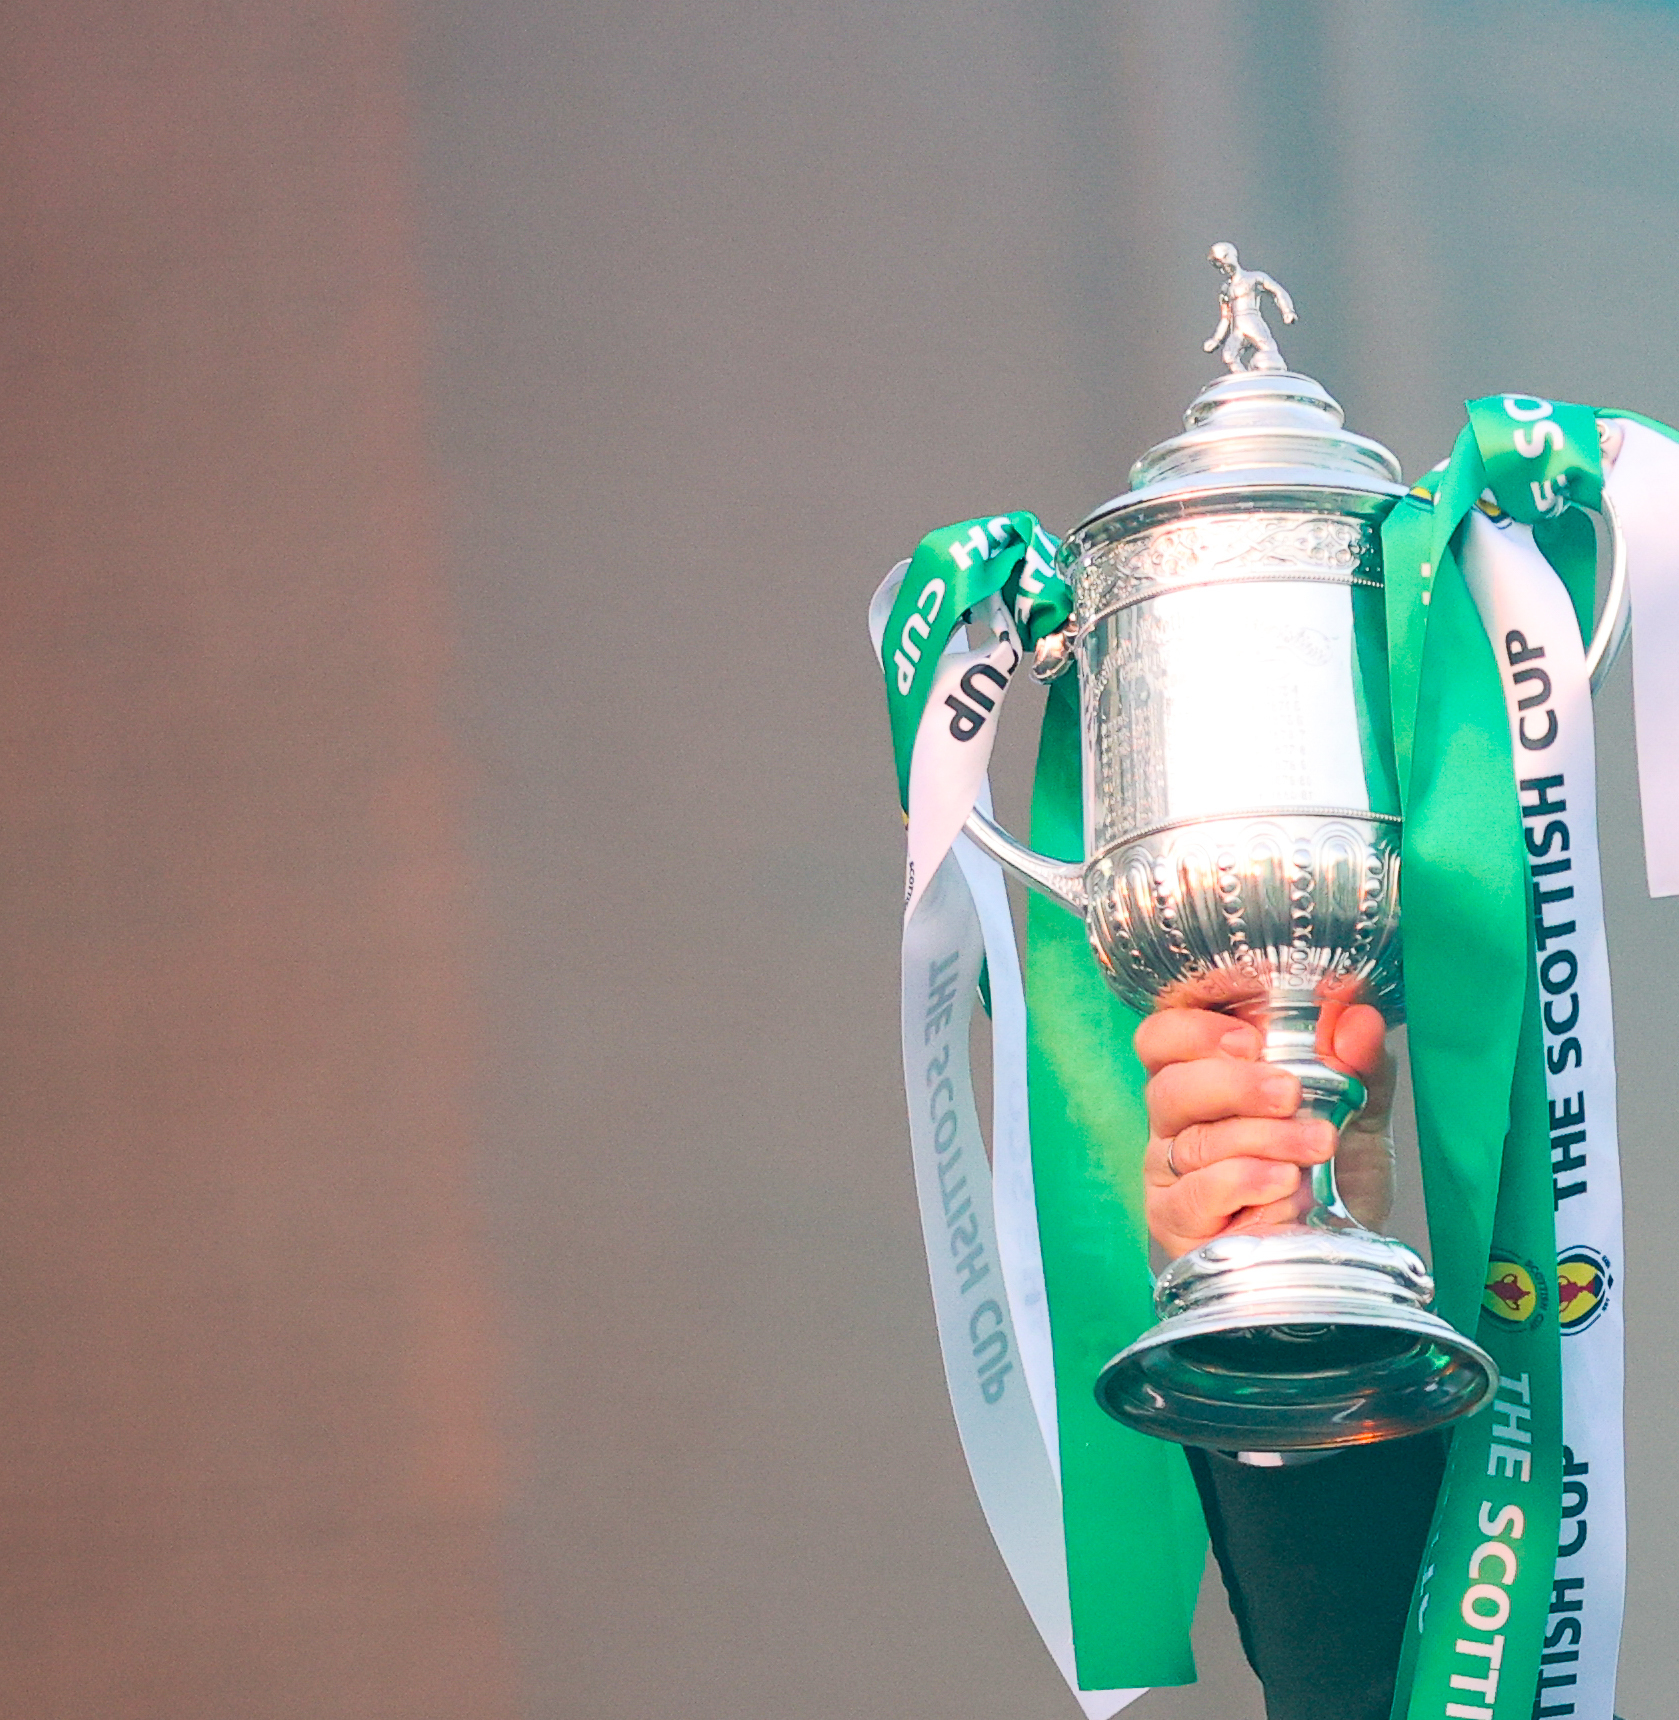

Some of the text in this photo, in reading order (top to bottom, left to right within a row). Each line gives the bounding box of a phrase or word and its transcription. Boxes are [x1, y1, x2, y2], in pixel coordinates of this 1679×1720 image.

[893, 577, 947, 696] CUP
[1505, 629, 1588, 1212] THE SCOTTISH CUP
[1487, 1372, 1532, 1484] THE
[1559, 1444, 1590, 1559] CUP
